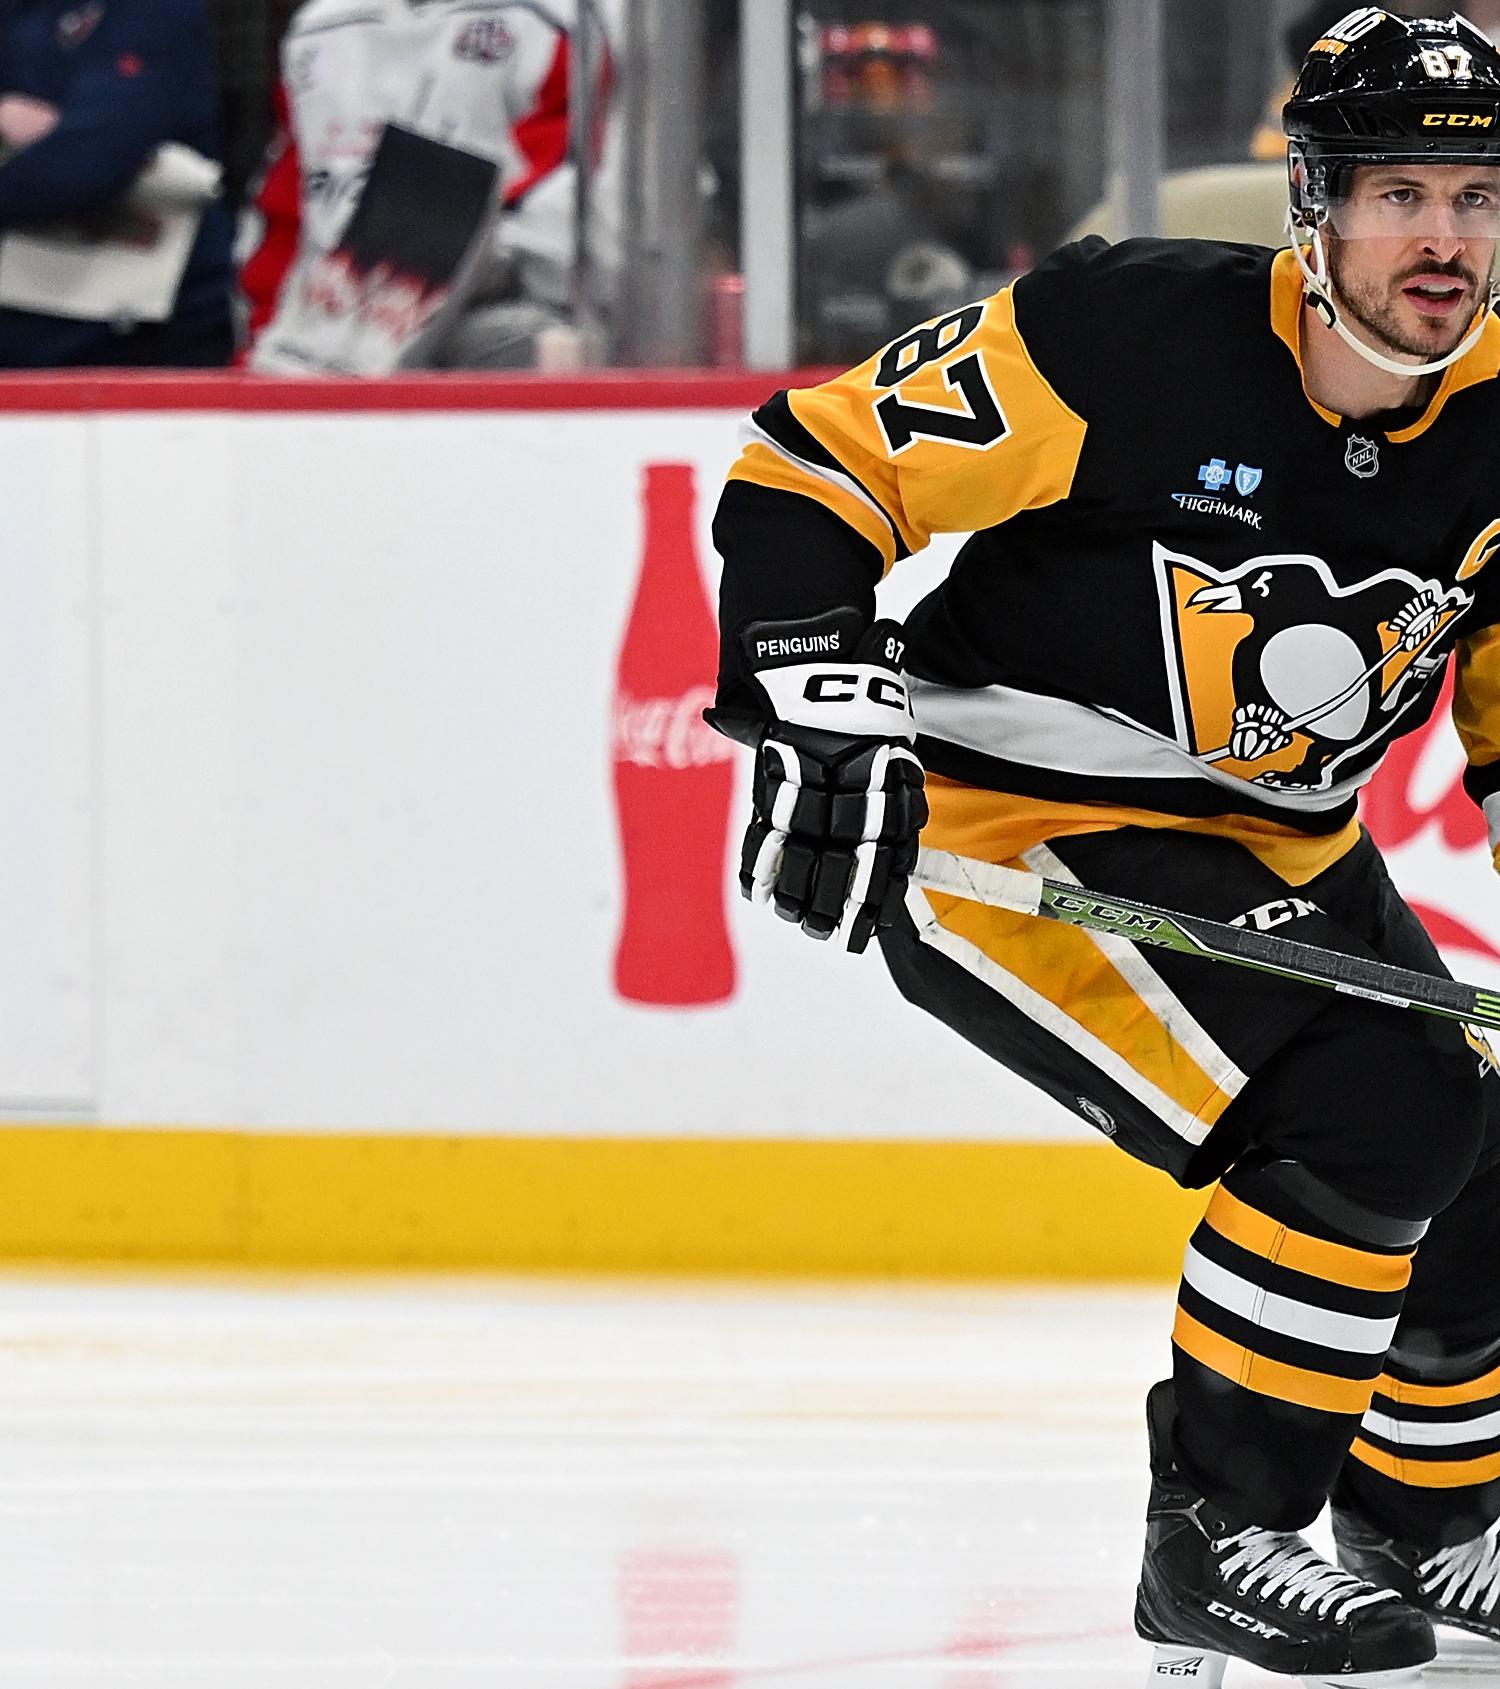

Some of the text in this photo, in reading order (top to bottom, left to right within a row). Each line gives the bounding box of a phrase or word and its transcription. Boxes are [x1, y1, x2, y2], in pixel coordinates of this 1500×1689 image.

[1419, 46, 1473, 79] 87
[1422, 113, 1493, 128] CCM
[871, 302, 1013, 459] 87
[1352, 449, 1372, 468] NHL
[1178, 496, 1263, 530] HIGHMARK
[756, 632, 840, 658] PENGUINS
[884, 637, 905, 664] 87
[802, 674, 915, 719] CC
[1050, 892, 1166, 933] CCM
[1206, 1600, 1284, 1640] CCM
[1156, 1665, 1199, 1678] CCM
